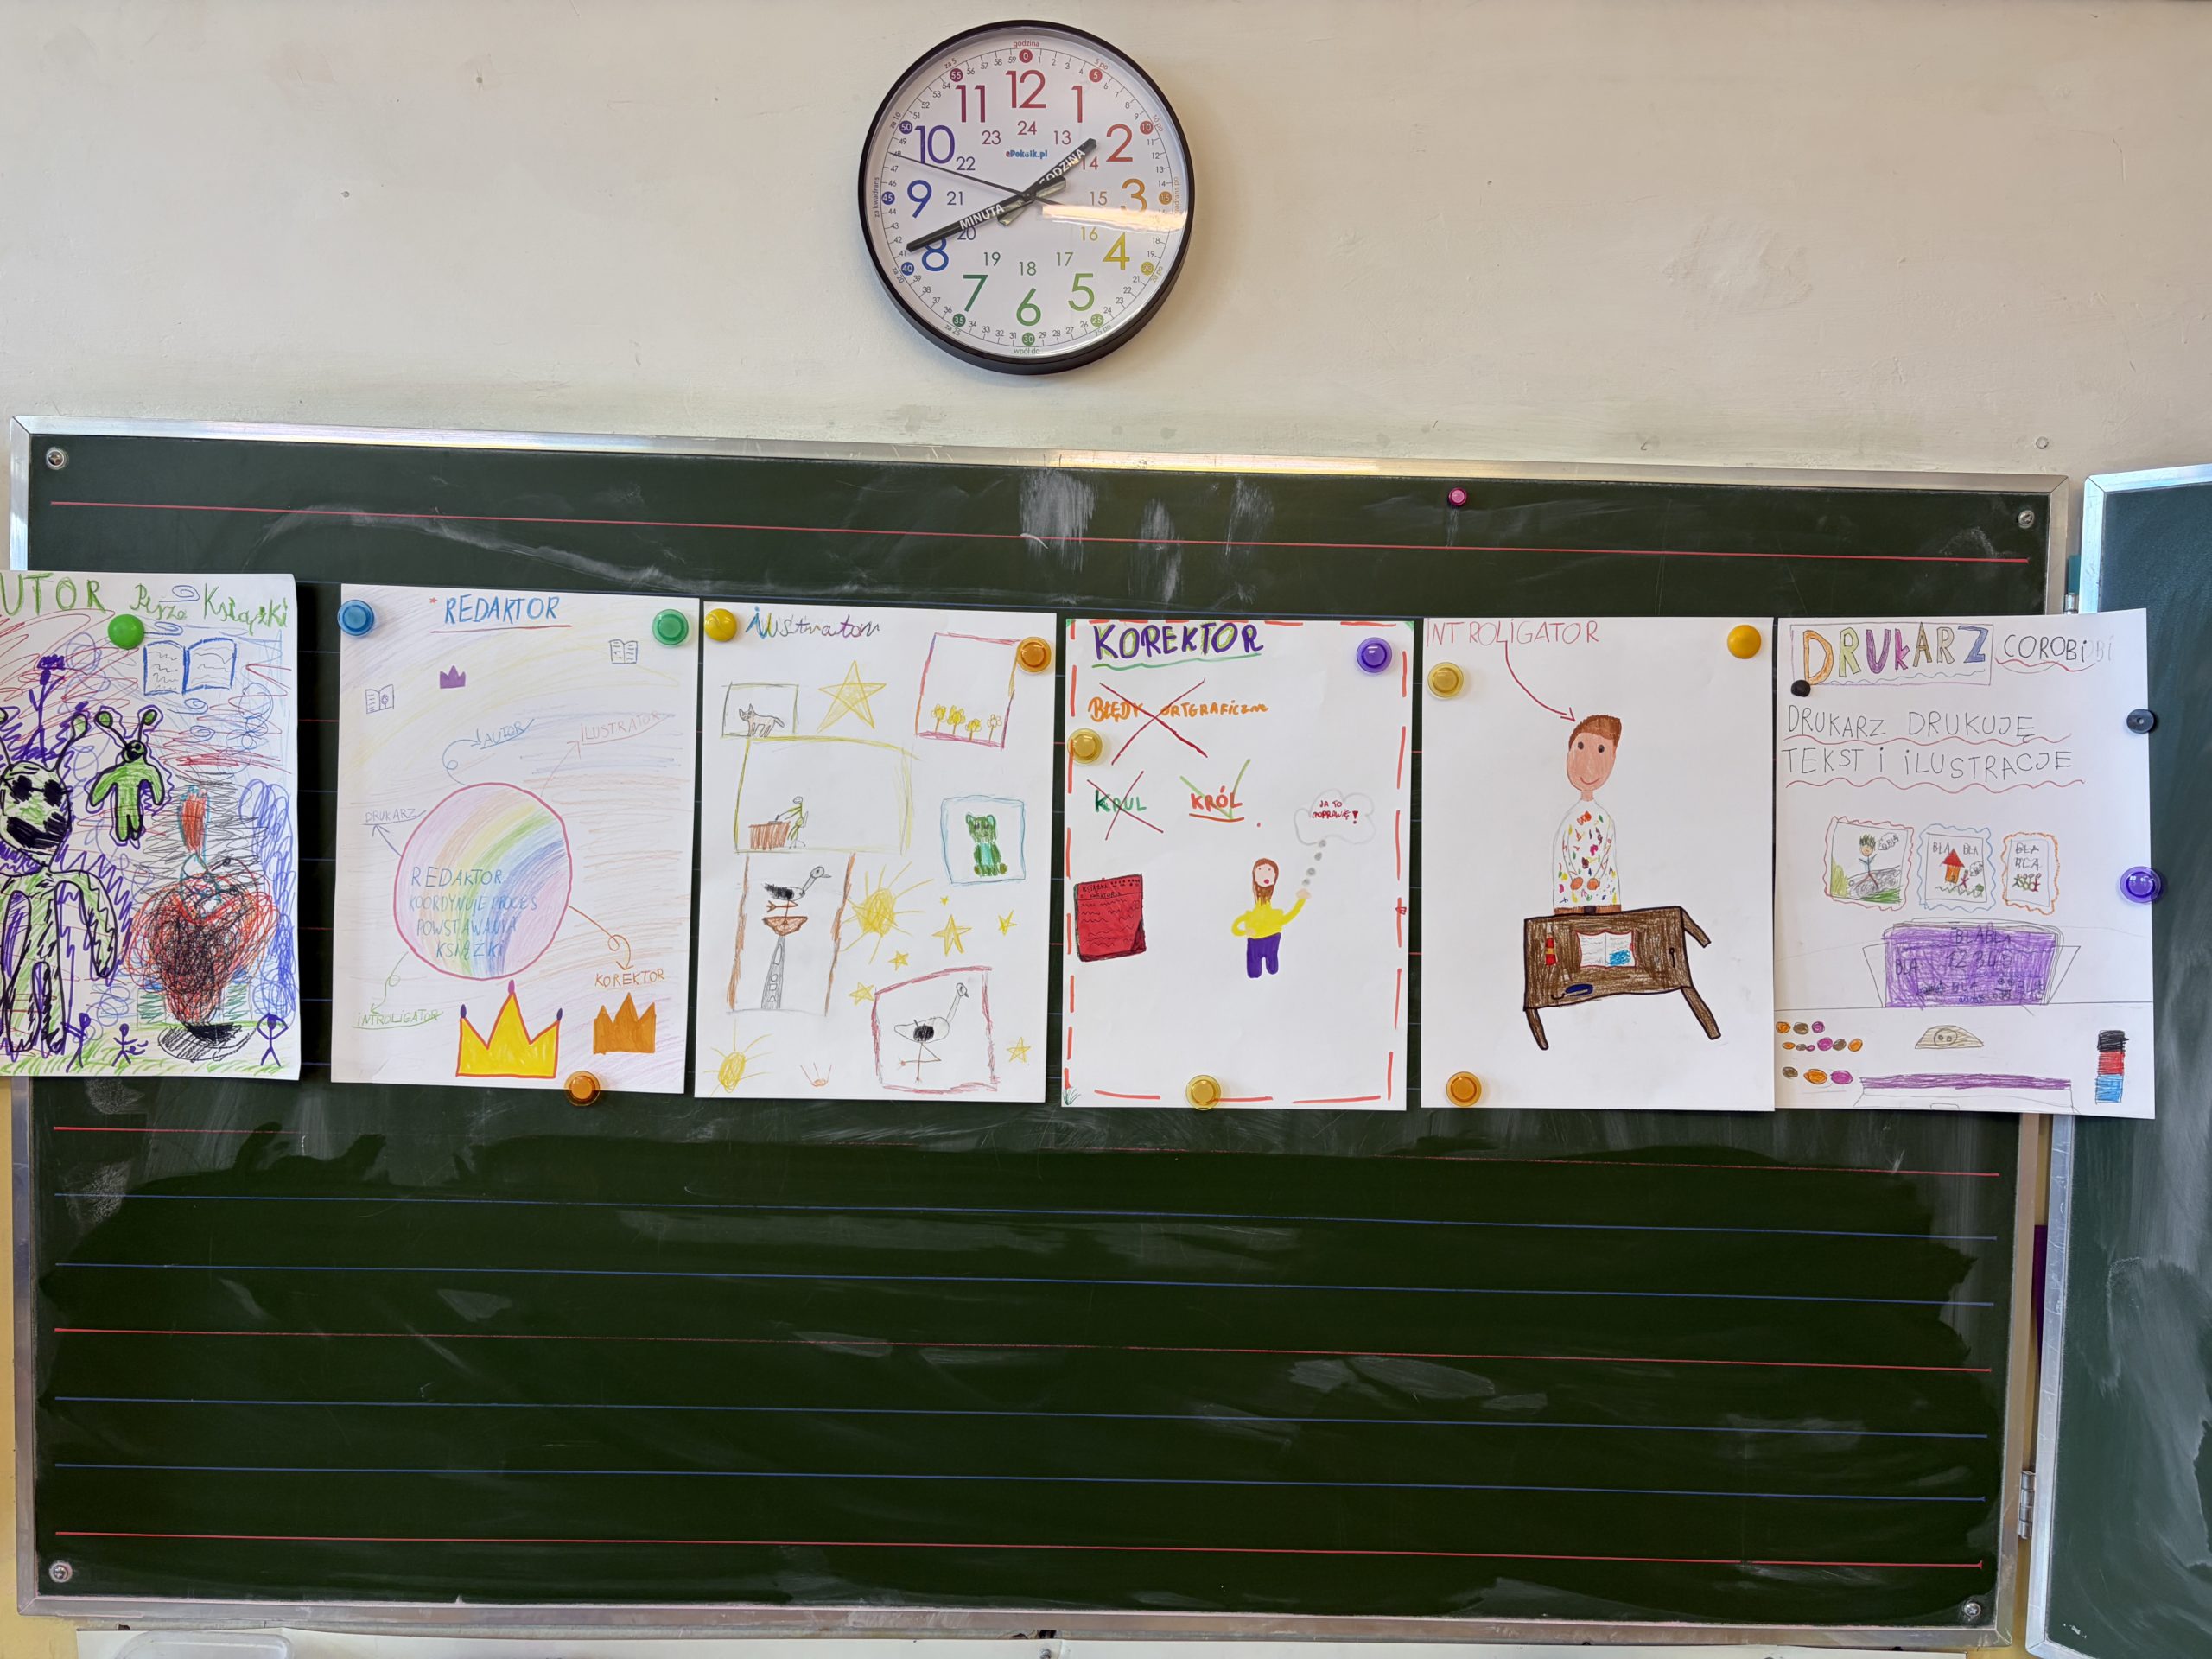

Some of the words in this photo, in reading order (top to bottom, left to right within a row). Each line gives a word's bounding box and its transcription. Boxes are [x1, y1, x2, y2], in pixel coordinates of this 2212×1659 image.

[1013, 39, 1040, 49] godzina
[1022, 52, 1029, 60] 0
[1098, 62, 1109, 71] po
[951, 71, 962, 79] 55
[1005, 69, 1046, 109] 12
[955, 85, 986, 123] 11
[1071, 85, 1083, 124] 1
[893, 111, 901, 120] 10
[982, 130, 1001, 145] 23
[1017, 120, 1037, 136] 24
[1053, 130, 1071, 145] 13
[914, 124, 956, 164] 10
[1106, 124, 1133, 162] 2
[956, 156, 976, 171] 22
[1081, 156, 1099, 170] 14
[882, 194, 893, 202] 45
[907, 180, 932, 219] 9
[946, 191, 963, 206] 21
[1090, 191, 1108, 206] 15
[1121, 178, 1147, 213] 3
[959, 203, 1005, 230] MINUTA
[957, 226, 976, 240] 20
[1081, 226, 1098, 241] 16
[921, 236, 949, 271] 8
[983, 251, 1001, 266] 19
[1056, 251, 1073, 266] 17
[1102, 232, 1130, 270] 4
[902, 264, 913, 273] 40
[1019, 261, 1036, 276] 18
[963, 274, 988, 312] 7
[1068, 273, 1095, 311] 5
[1016, 288, 1041, 327] 6
[444, 594, 560, 625] REDAKTOR
[1093, 622, 1264, 659] KOREKTOR
[1802, 622, 1988, 685] DRUKARZ
[580, 710, 660, 741] ILUSTRATOR
[1788, 704, 1887, 738] DRUKARZ
[483, 721, 524, 746] AUTOR
[1781, 747, 1864, 774] TEKST
[1095, 789, 1147, 812] KRUL
[1191, 785, 1243, 812] KRÓL
[365, 809, 416, 823] DRUKARZ
[411, 866, 502, 887] REDAKTOR
[594, 968, 664, 988] KOREKTOR
